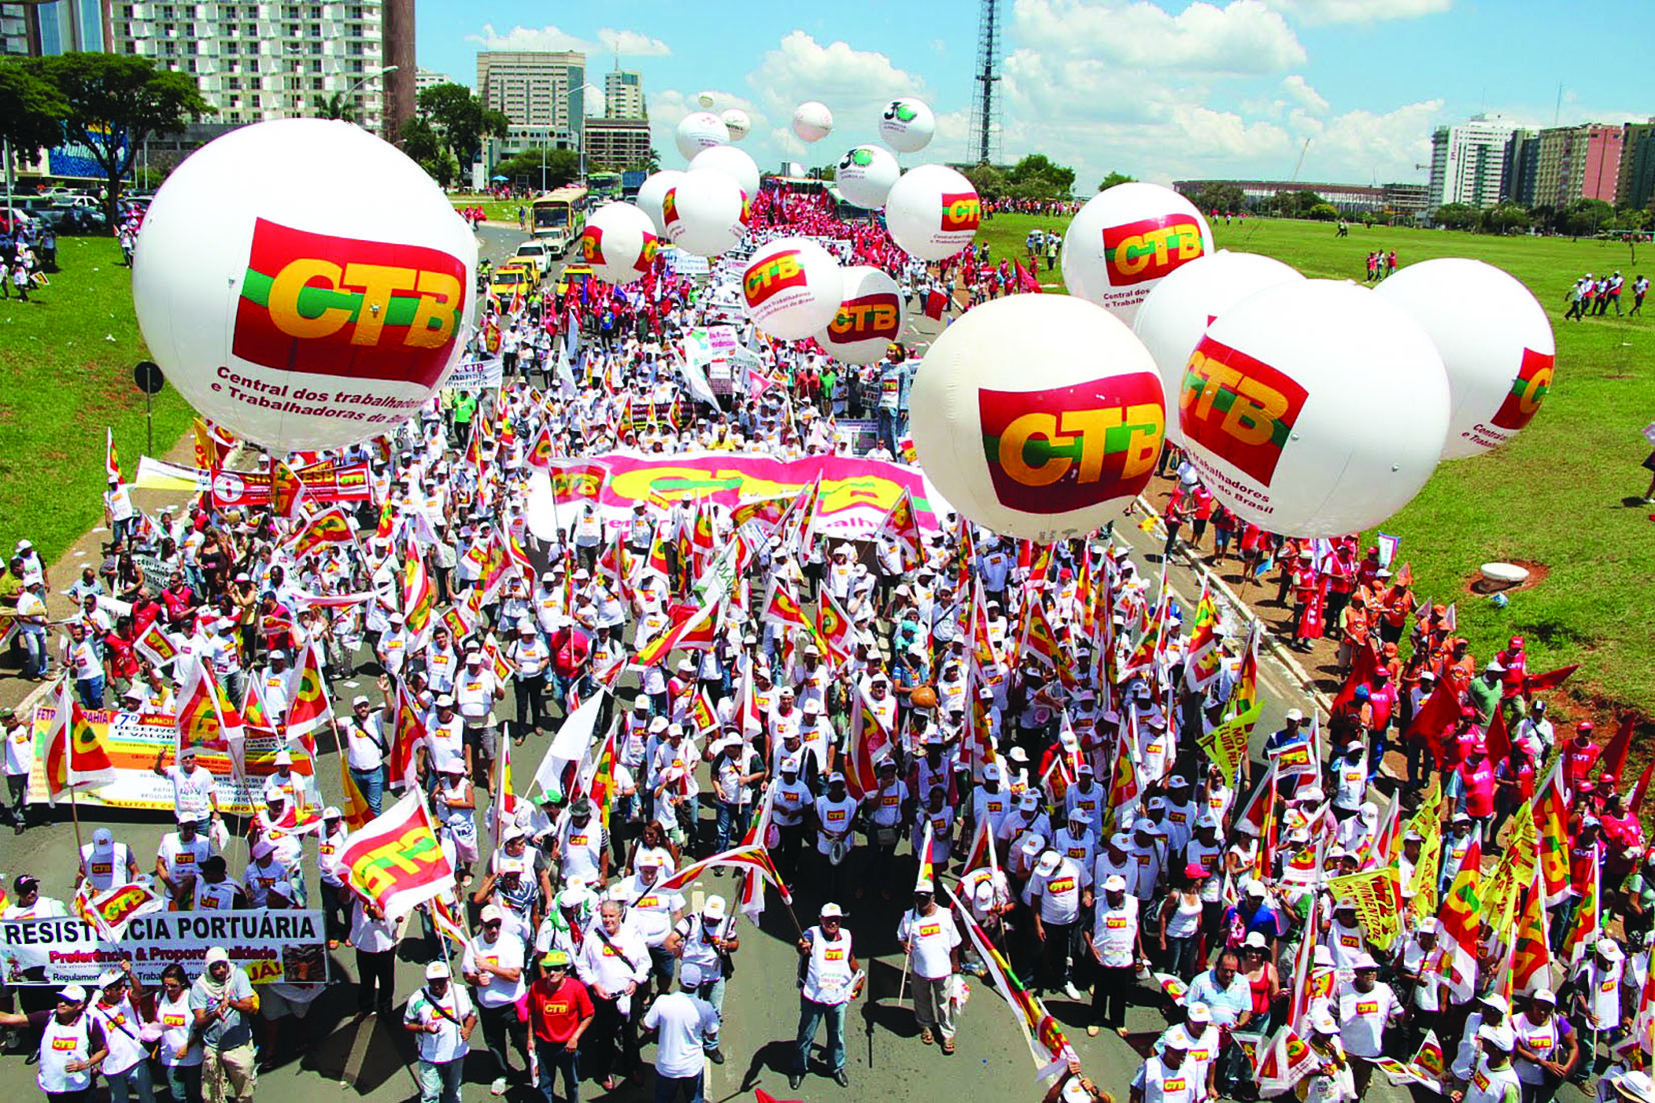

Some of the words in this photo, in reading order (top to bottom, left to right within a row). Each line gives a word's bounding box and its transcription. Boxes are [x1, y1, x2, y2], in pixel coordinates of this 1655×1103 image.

[1114, 223, 1202, 278] CTB
[745, 253, 801, 299] CTB
[1103, 290, 1133, 300] Central
[1112, 298, 1144, 307] Trabalh
[268, 258, 462, 350] CTB
[830, 303, 897, 334] CTB
[217, 366, 289, 397] Central
[293, 388, 329, 402] dos
[210, 382, 222, 392] e
[229, 386, 366, 421] Trabalhadoras
[366, 413, 388, 424] do
[1000, 403, 1165, 487] CTB
[553, 473, 599, 496] CTB
[1193, 452, 1270, 503] trabalhadores
[1218, 484, 1232, 496] do
[1235, 493, 1274, 514] Brasil
[37, 708, 56, 721] FETR
[115, 725, 175, 734] DESENVO
[828, 812, 845, 820] CTB
[102, 889, 147, 922] CTB
[5, 919, 171, 945] RESISTCIA
[178, 911, 316, 940] PORTUÁRIA
[1107, 918, 1127, 928] CTB
[135, 947, 149, 962] &
[151, 946, 278, 962] Proporcalidade
[825, 951, 843, 959] CTB
[53, 973, 101, 982] Regulamen
[138, 972, 162, 981] Traba
[249, 960, 283, 982] JÁ!
[545, 1003, 568, 1013] CTB
[1357, 1002, 1378, 1013] CTB
[164, 1015, 185, 1025] CTB
[53, 1039, 77, 1049] CTB
[1530, 1037, 1552, 1047] CTB
[1164, 1080, 1186, 1091] CTB
